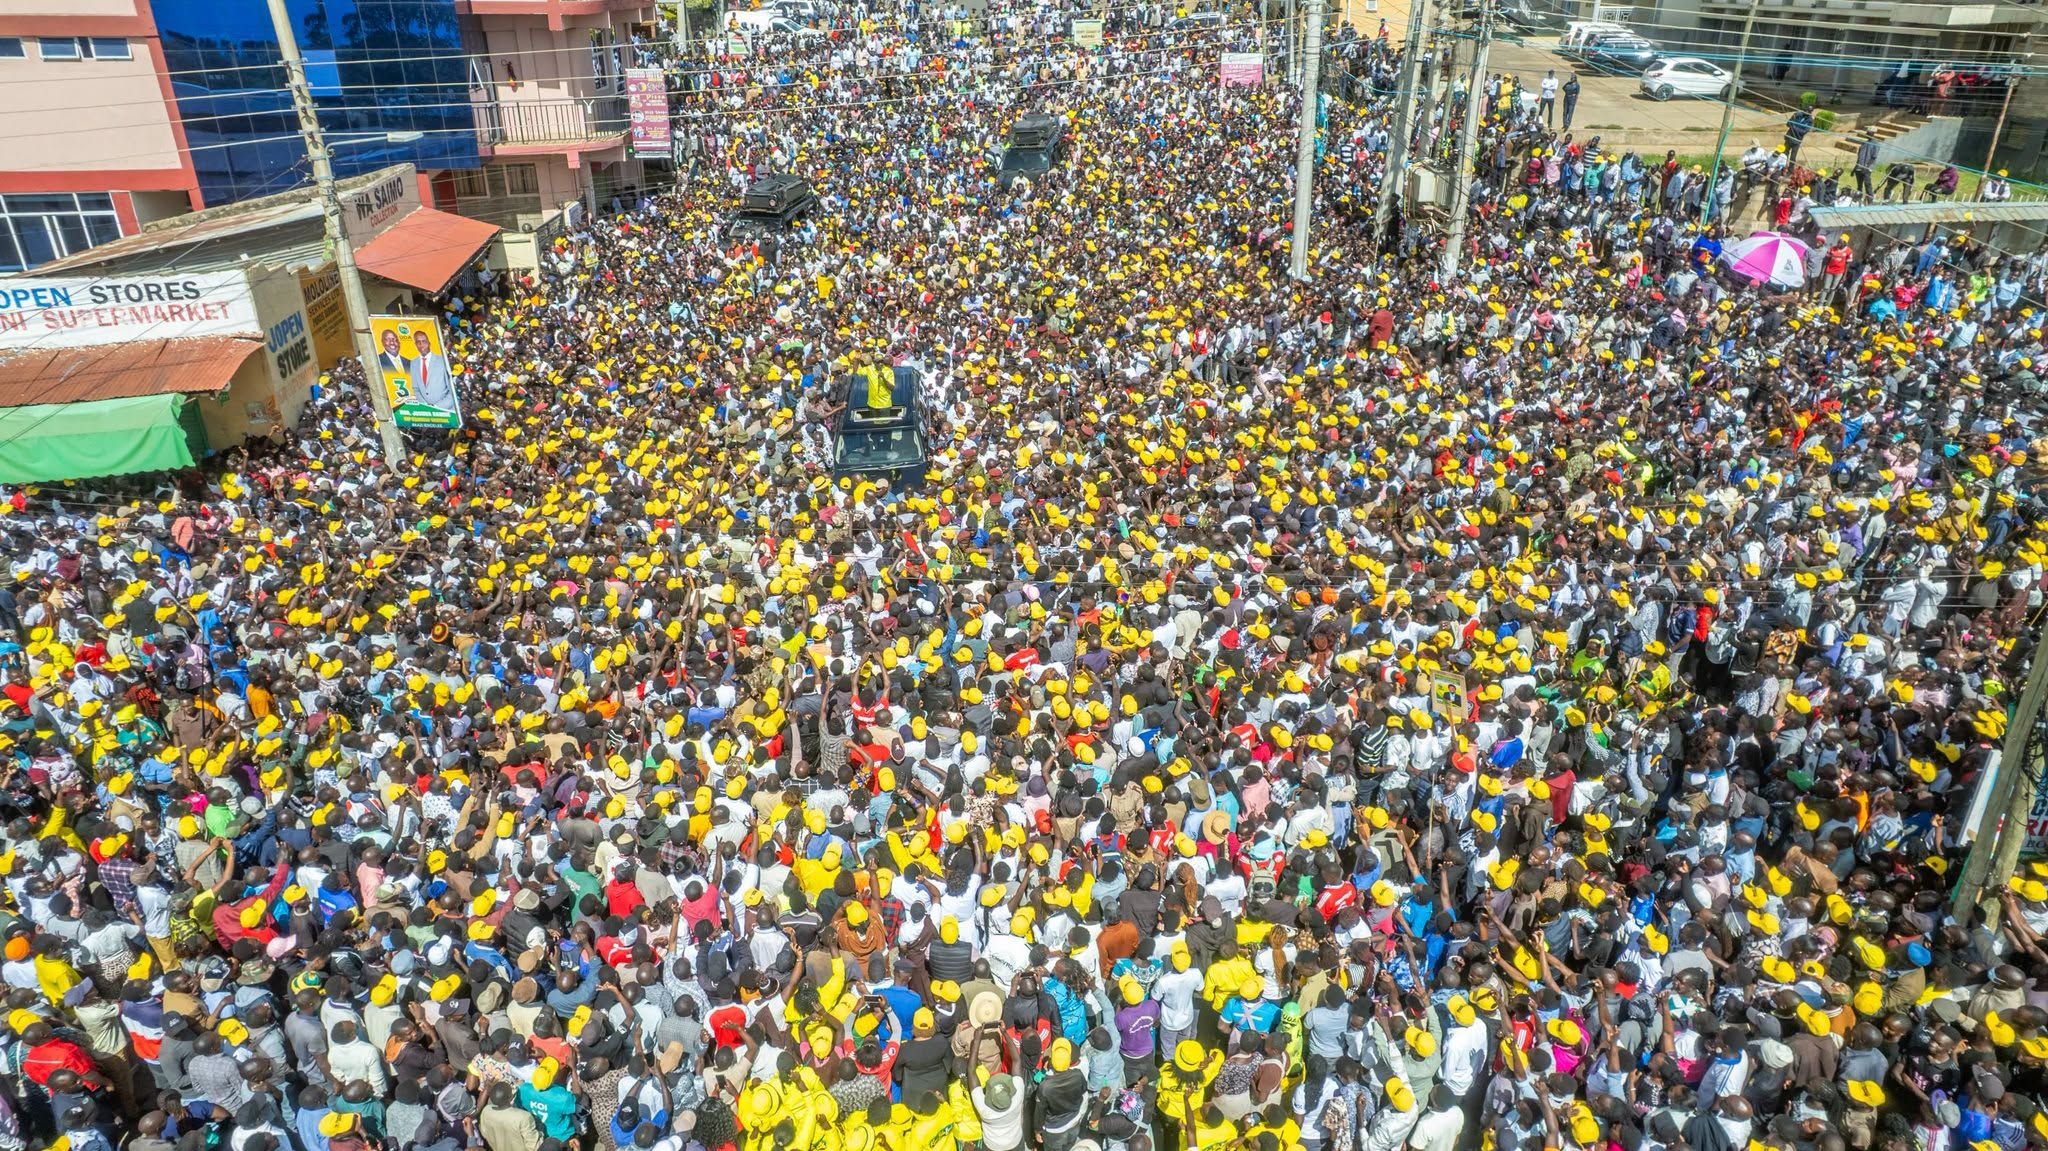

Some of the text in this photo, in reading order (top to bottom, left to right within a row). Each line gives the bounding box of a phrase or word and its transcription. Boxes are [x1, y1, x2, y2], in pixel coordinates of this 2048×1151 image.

[374, 176, 404, 210] SAIMO
[370, 203, 399, 228] COLLECTION
[89, 280, 201, 305] STORES
[42, 300, 230, 330] SUPERMARKET
[268, 310, 305, 354] JOPEN
[277, 336, 311, 379] STORE
[393, 378, 410, 398] 3
[530, 1101, 548, 1111] KOI
